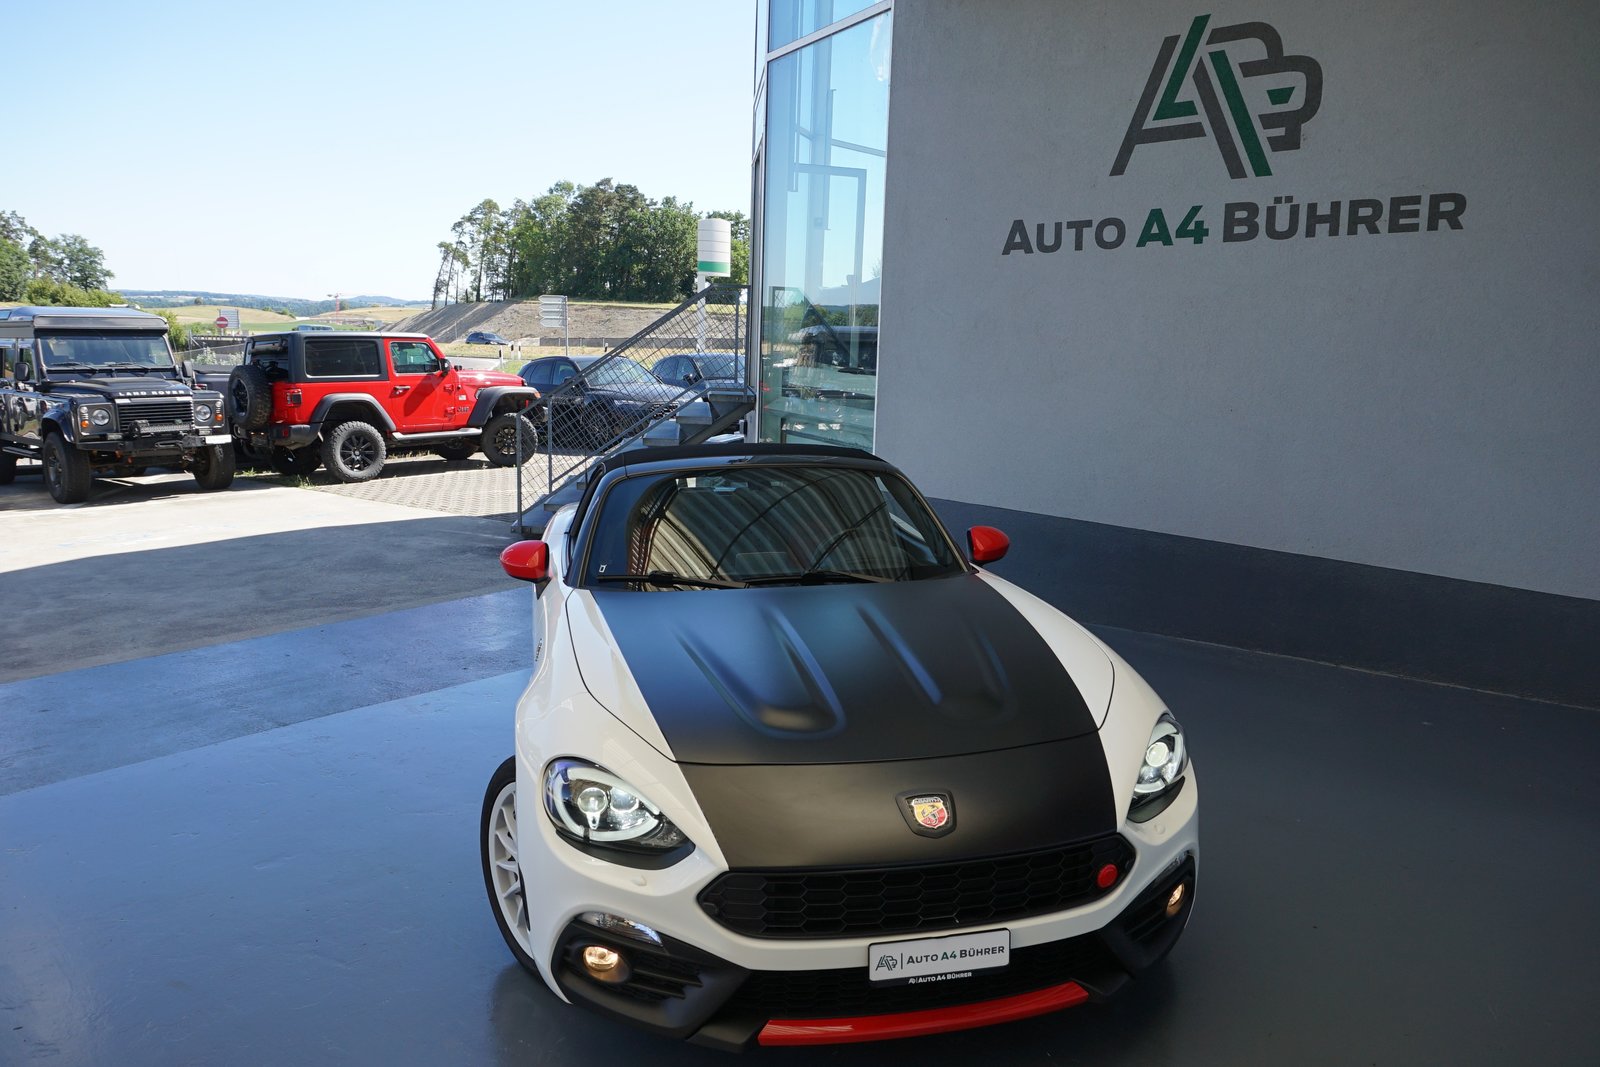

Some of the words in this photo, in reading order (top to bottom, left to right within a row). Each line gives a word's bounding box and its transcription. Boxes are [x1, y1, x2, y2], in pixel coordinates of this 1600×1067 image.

[1001, 217, 1127, 256] AUTO
[1136, 205, 1210, 248] A4
[1222, 192, 1468, 243] BÜHRER
[906, 954, 939, 965] AUTO
[940, 951, 957, 961] A4
[959, 945, 1005, 959] BÜHRER
